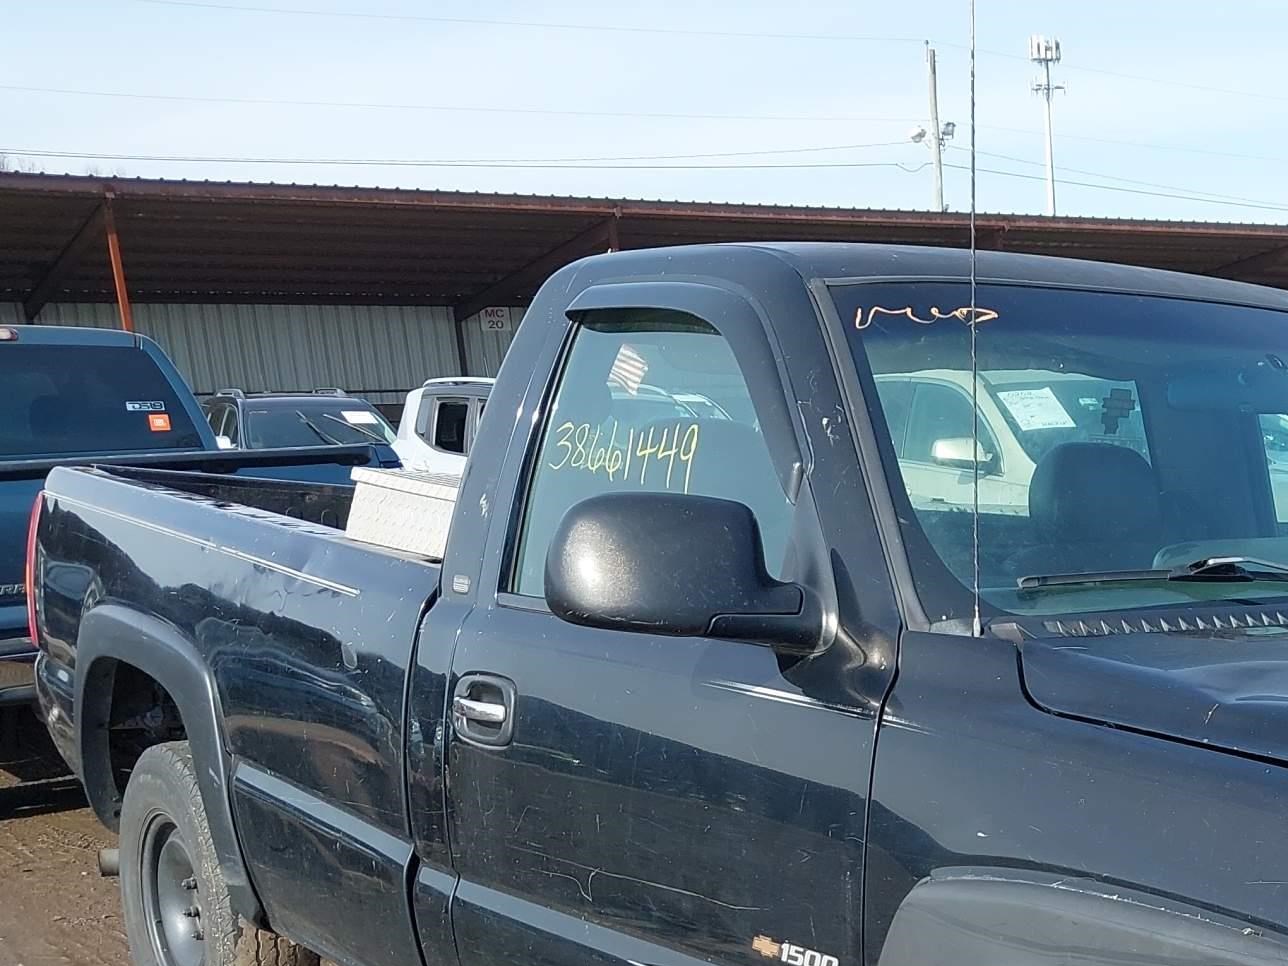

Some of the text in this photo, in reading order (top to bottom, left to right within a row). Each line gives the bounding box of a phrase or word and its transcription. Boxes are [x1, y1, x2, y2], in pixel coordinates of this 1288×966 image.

[485, 309, 504, 318] MC
[488, 320, 504, 329] 20
[549, 420, 698, 495] 38661449
